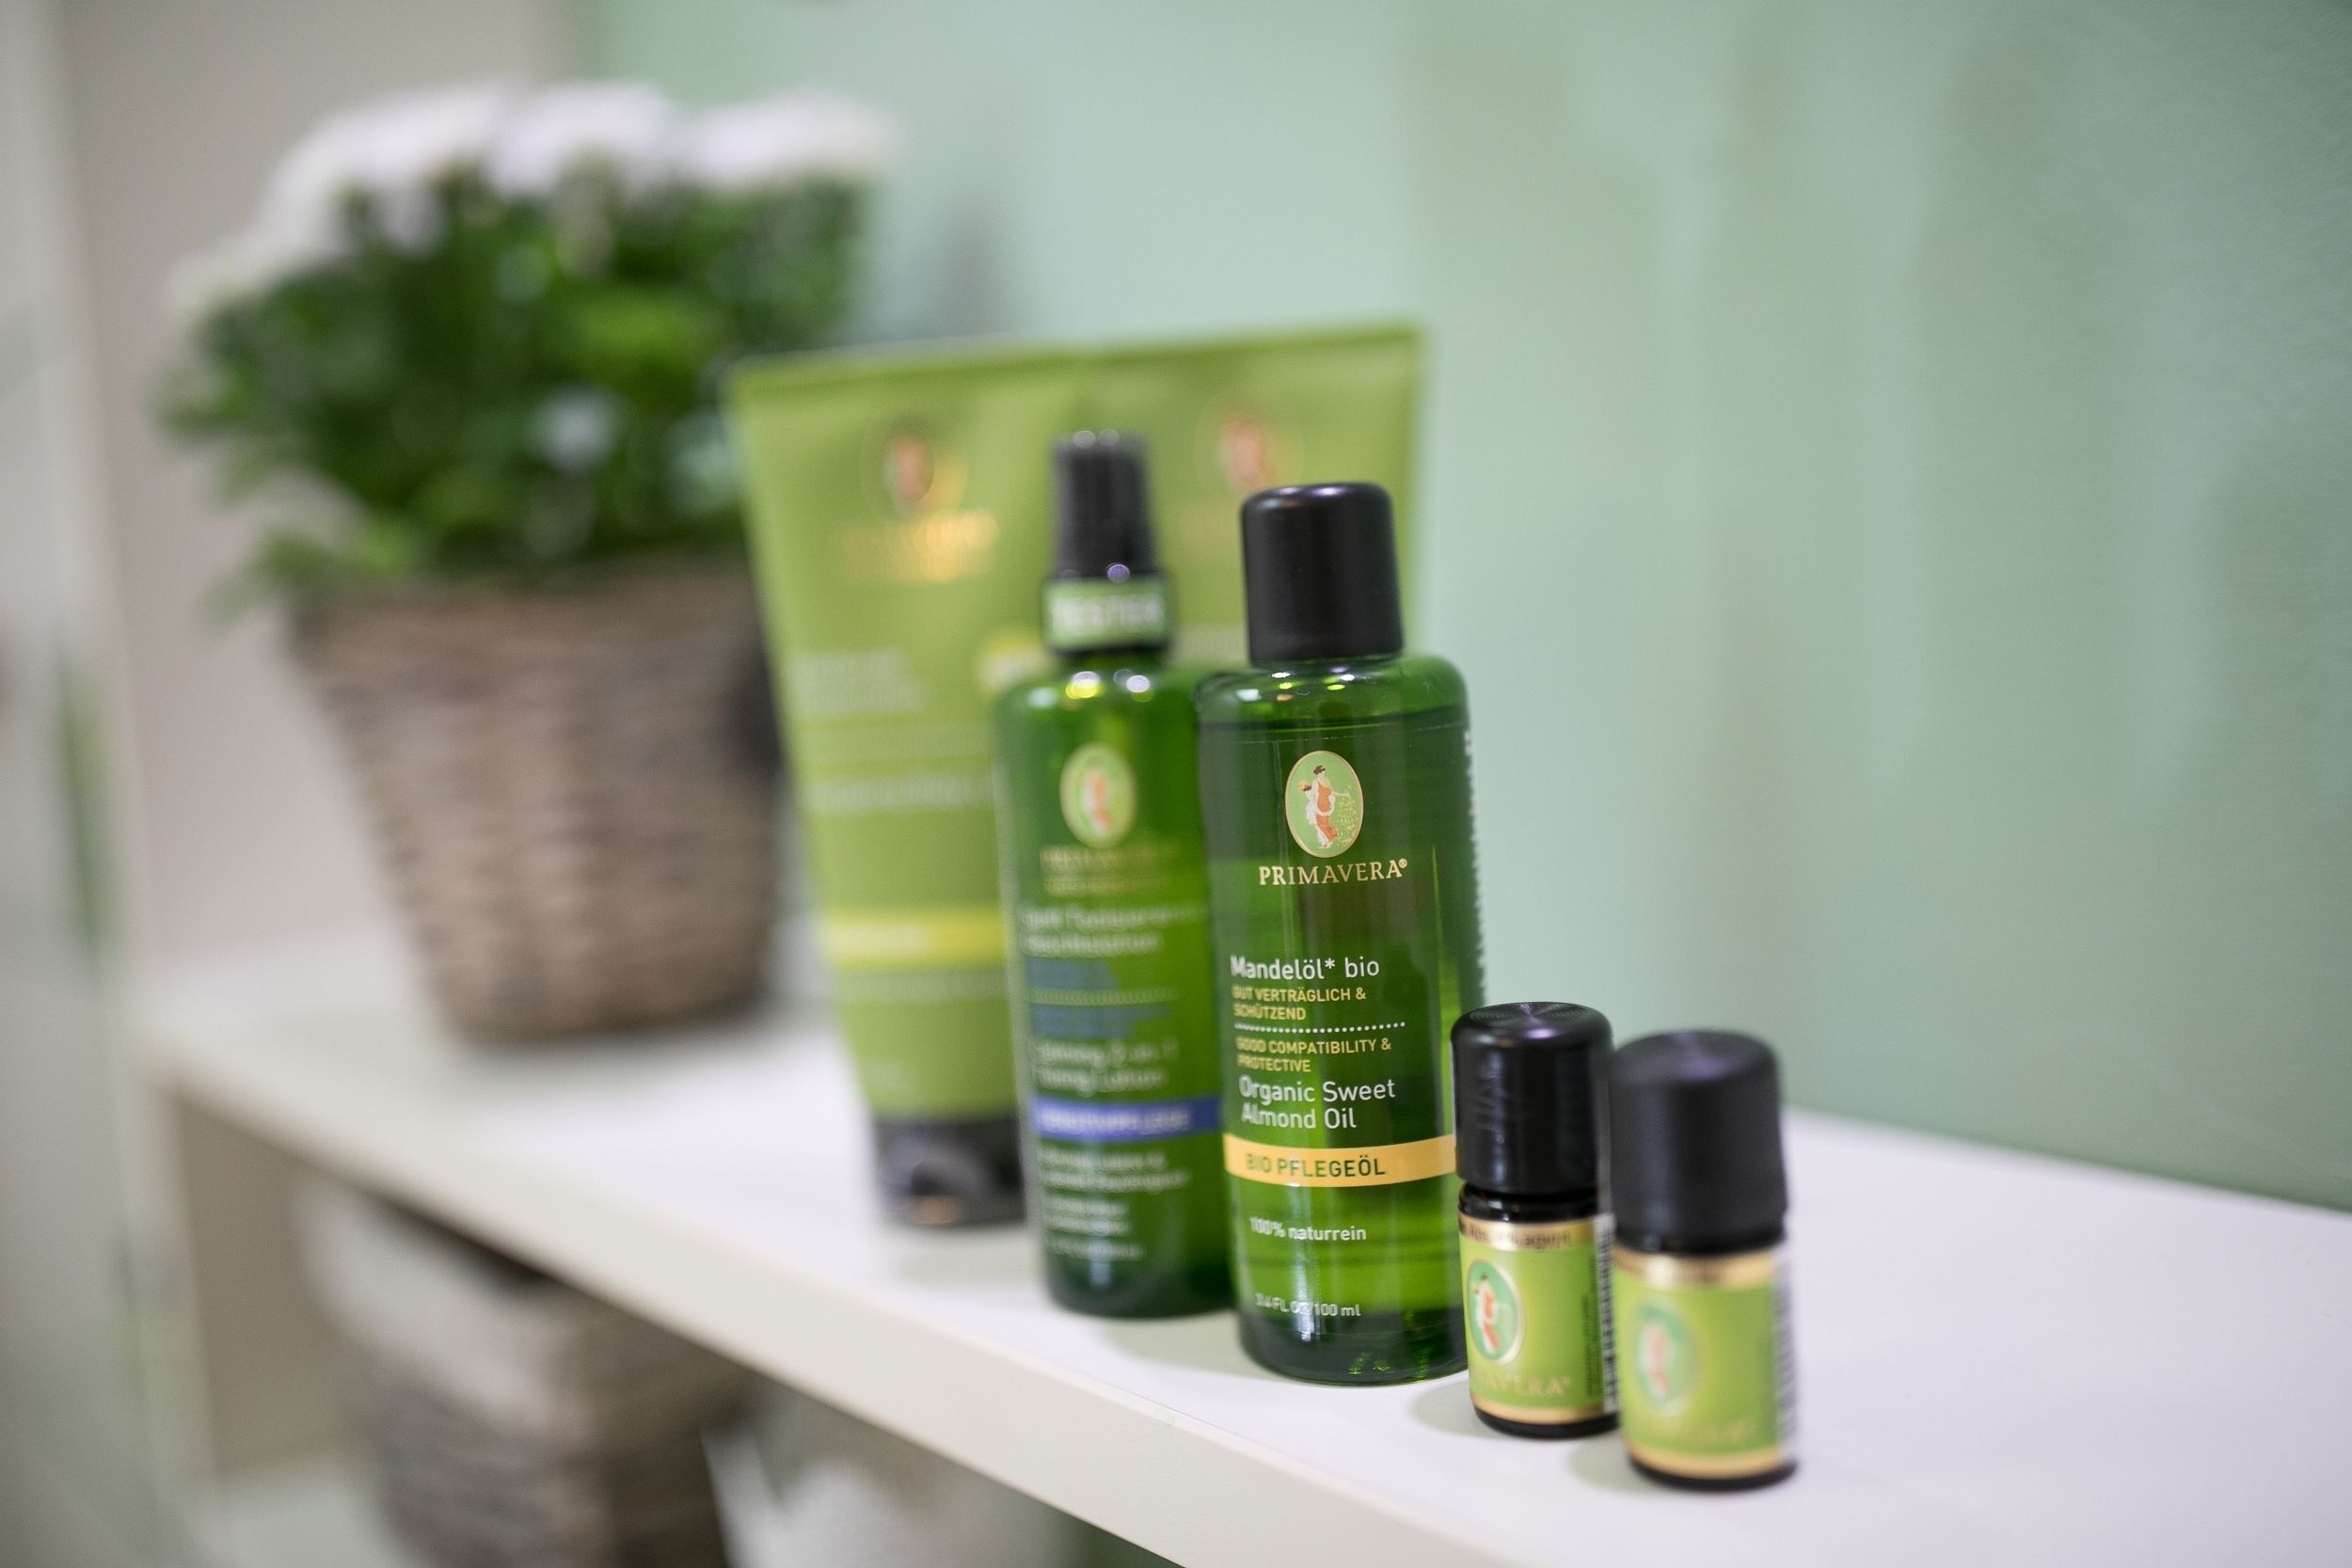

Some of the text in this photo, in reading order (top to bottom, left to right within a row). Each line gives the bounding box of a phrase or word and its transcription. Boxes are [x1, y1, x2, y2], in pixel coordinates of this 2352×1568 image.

[1258, 858, 1408, 886] PRIMAVERA®
[1344, 957, 1380, 977] bio
[1232, 985, 1367, 1003] GUT VERTRÄGLICH &
[1233, 1004, 1307, 1022] SCHÜTZEND
[1236, 1037, 1392, 1055] GOOD COMPATIBILITY &
[1236, 1054, 1312, 1073] PROTECTIVE
[1238, 1074, 1396, 1106] Organic Sweet
[1241, 1102, 1358, 1130] Almond Oil
[1246, 1152, 1387, 1178] BIO PFLEGEÖL
[1249, 1217, 1368, 1242] 100% naturrein
[1341, 1304, 1362, 1317] ml
